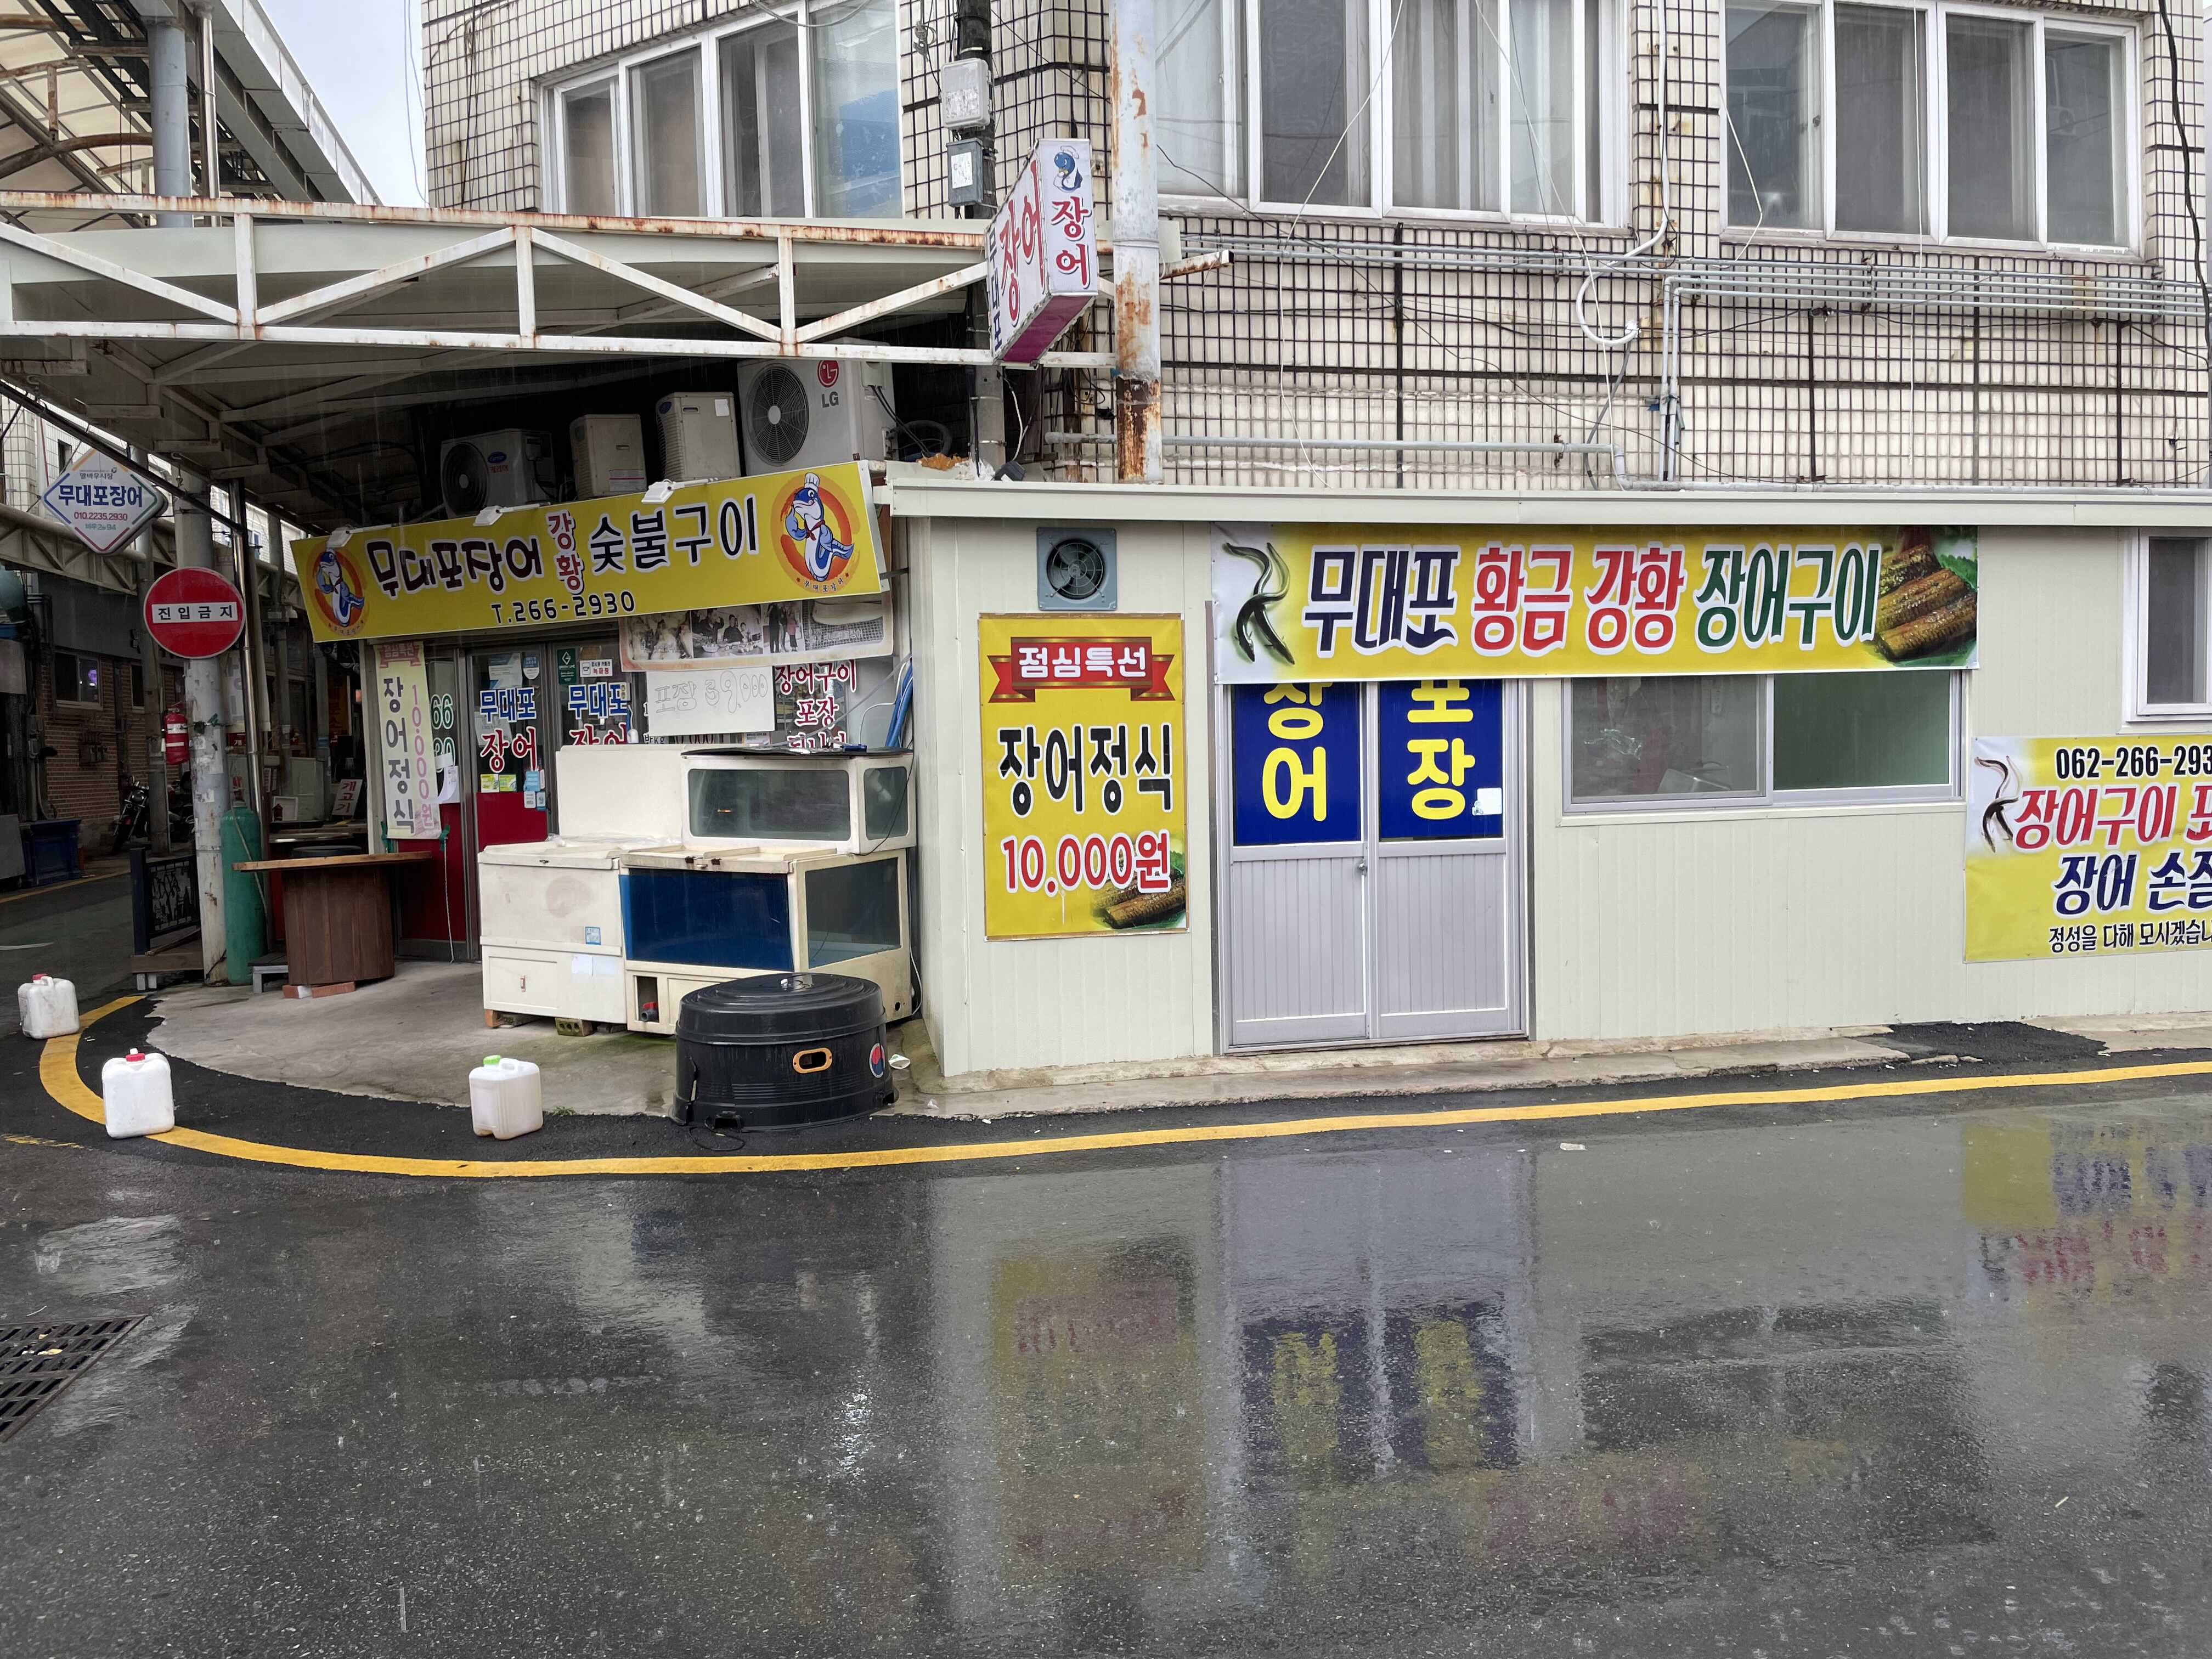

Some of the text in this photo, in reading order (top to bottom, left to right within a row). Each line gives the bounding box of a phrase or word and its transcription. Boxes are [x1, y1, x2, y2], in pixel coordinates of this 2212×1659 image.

[1000, 160, 1046, 323] 장어
[1051, 195, 1092, 290] 장어
[989, 229, 1002, 352] 무대포
[821, 391, 839, 408] LG
[58, 485, 143, 507] 무대포장어
[74, 512, 128, 521] 010.2235.2930
[366, 496, 757, 598] 무대포장어 강황 숯불구이
[157, 606, 234, 620] 진입금지
[492, 592, 635, 624] T.266-2930
[1304, 547, 1880, 652] 무대포 황금 강황 장어구이
[775, 659, 857, 696] 장어구이
[1019, 646, 1146, 678] 점심특선
[480, 688, 537, 723] 무대포
[568, 682, 628, 720] 무대포
[655, 681, 697, 713] 포장
[795, 696, 839, 729] 포장
[384, 676, 414, 834] 장어정식
[480, 726, 537, 773] 장어
[999, 725, 1171, 815] 장어정식
[2015, 786, 2177, 849] 장어구이
[1003, 833, 1171, 893] 10.000원
[2055, 854, 2137, 915] 장어
[2049, 926, 2097, 953] 정성을
[2103, 923, 2134, 948] 다해
